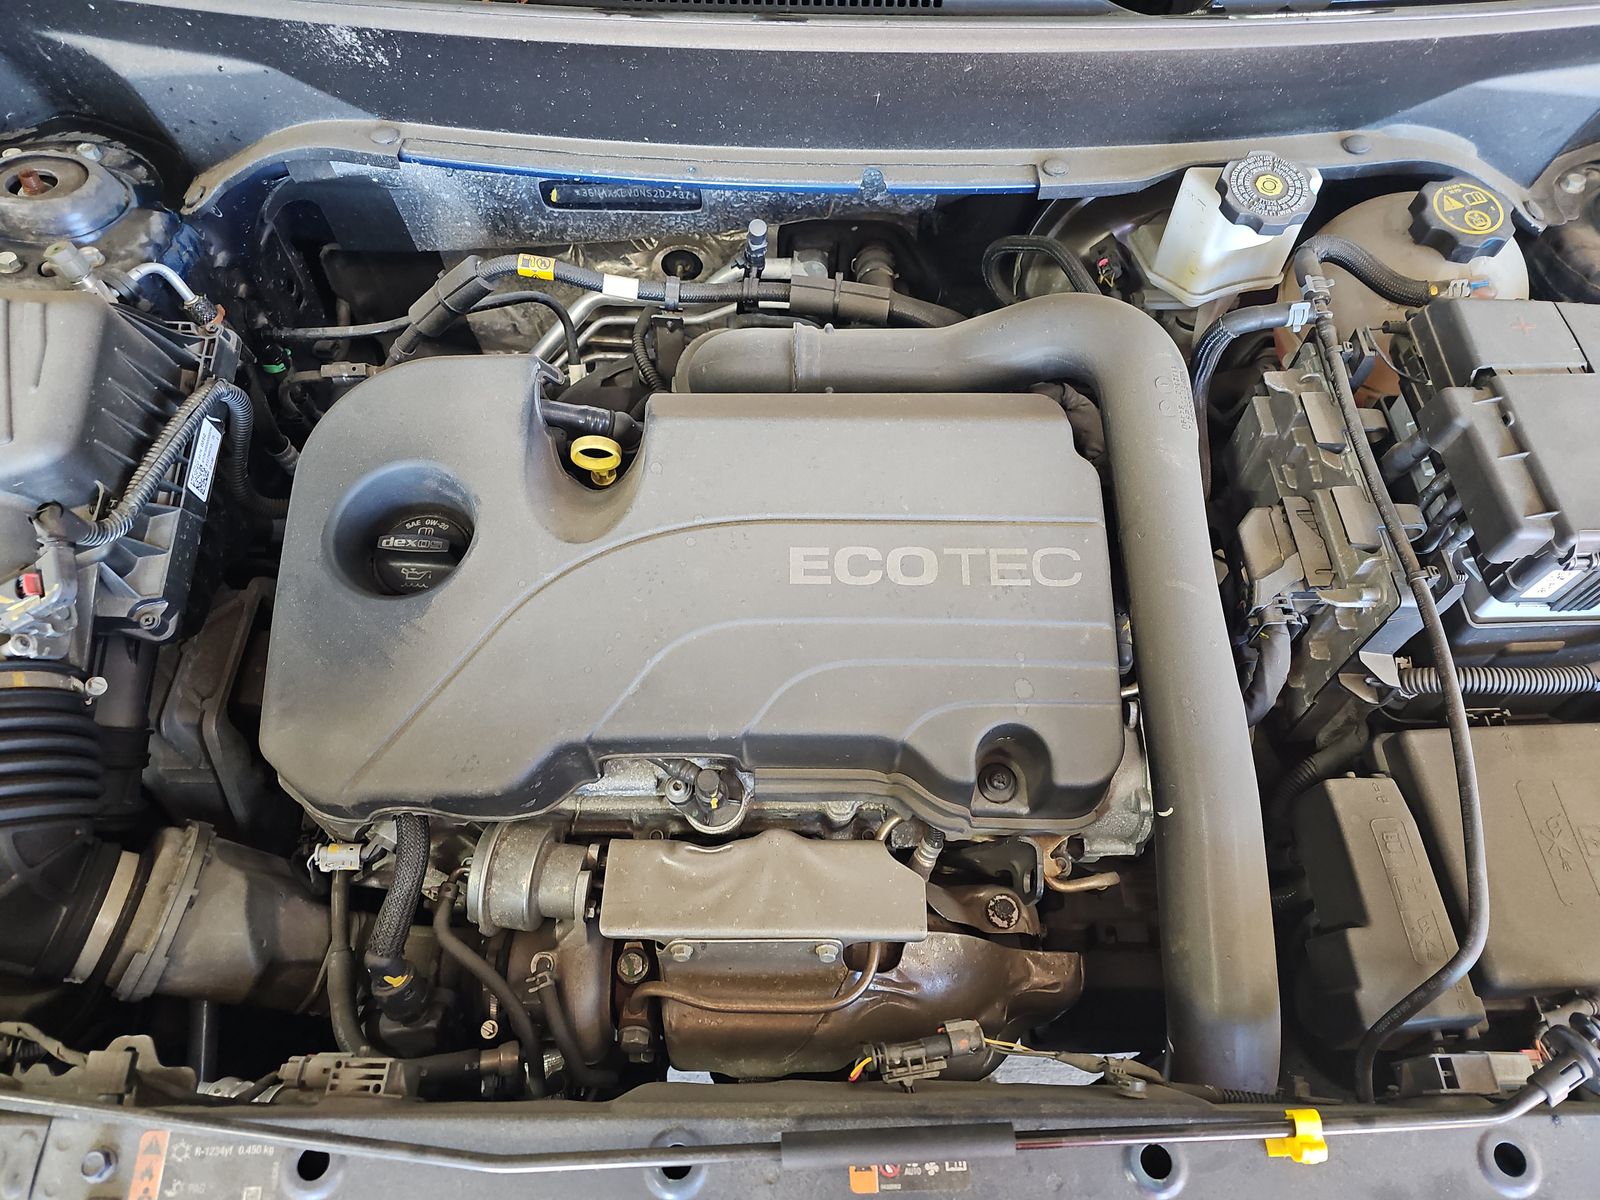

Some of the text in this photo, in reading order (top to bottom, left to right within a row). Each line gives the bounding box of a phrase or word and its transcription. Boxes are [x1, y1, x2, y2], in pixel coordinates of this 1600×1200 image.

[405, 518, 450, 531] SAE 0W-20
[381, 536, 443, 550] dexos
[789, 546, 1083, 587] ECOTEC
[263, 1144, 275, 1157] kg
